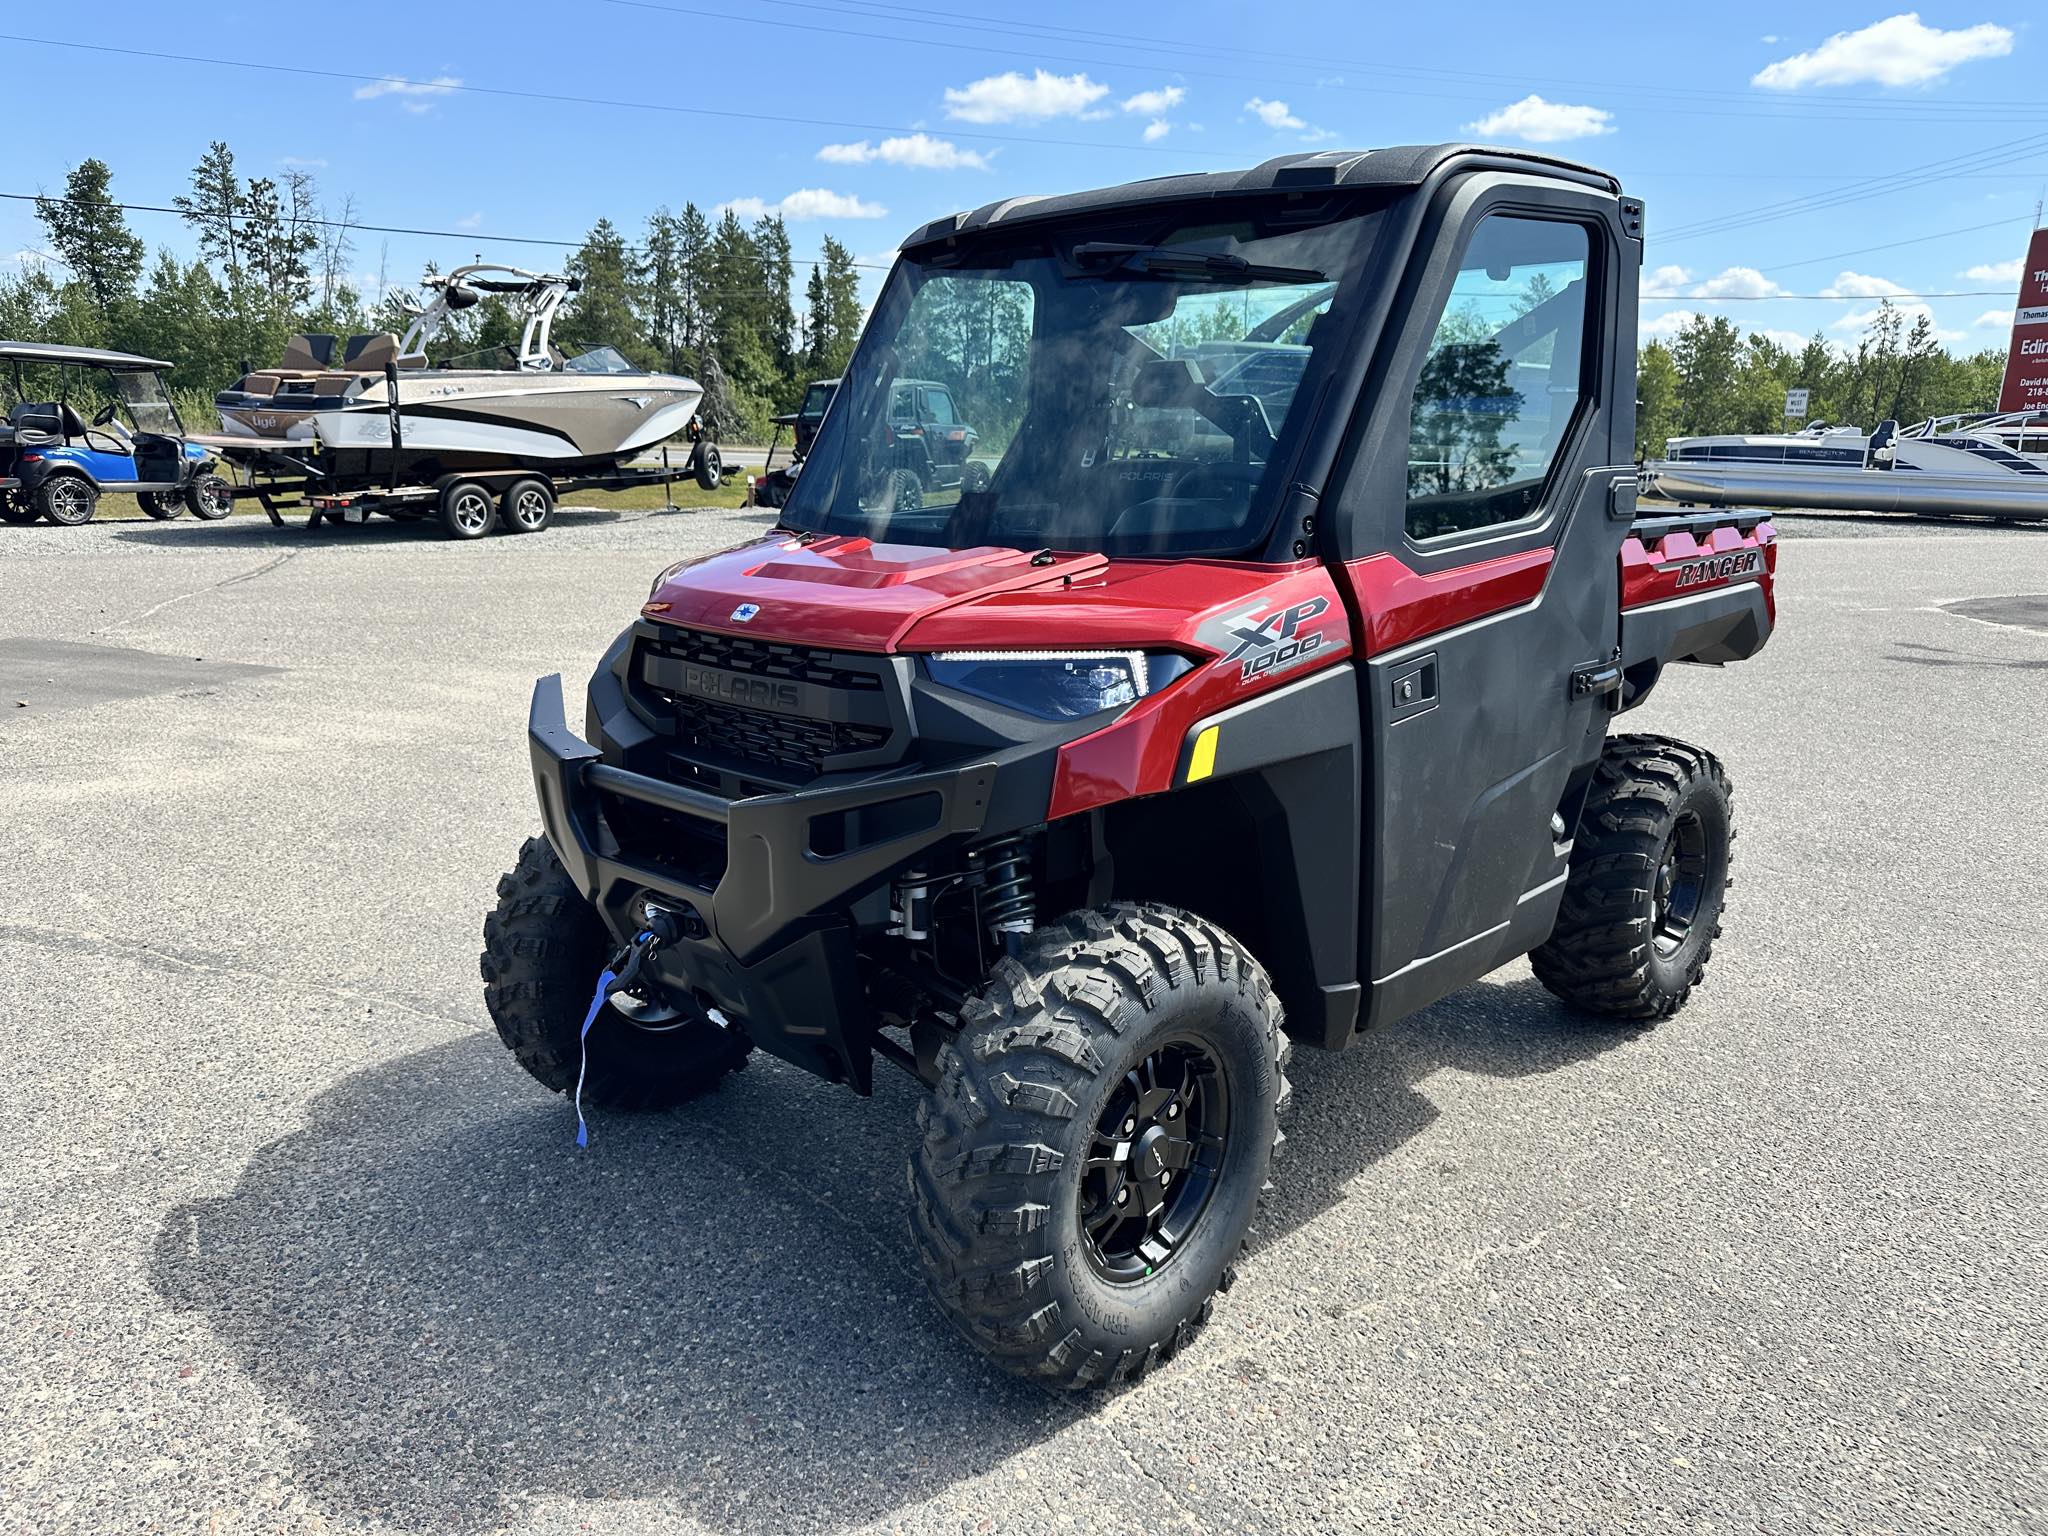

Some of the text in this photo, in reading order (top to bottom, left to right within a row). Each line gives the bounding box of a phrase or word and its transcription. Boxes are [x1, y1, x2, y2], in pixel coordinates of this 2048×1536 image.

[2020, 378, 2041, 387] David
[1120, 472, 1174, 481] POLARIS
[1676, 551, 1757, 587] RANGER
[1213, 595, 1330, 669] XP
[1240, 631, 1323, 680] 1000
[1242, 650, 1319, 686] DUAL OVERHEAD CAM
[686, 667, 799, 707] POLARIS
